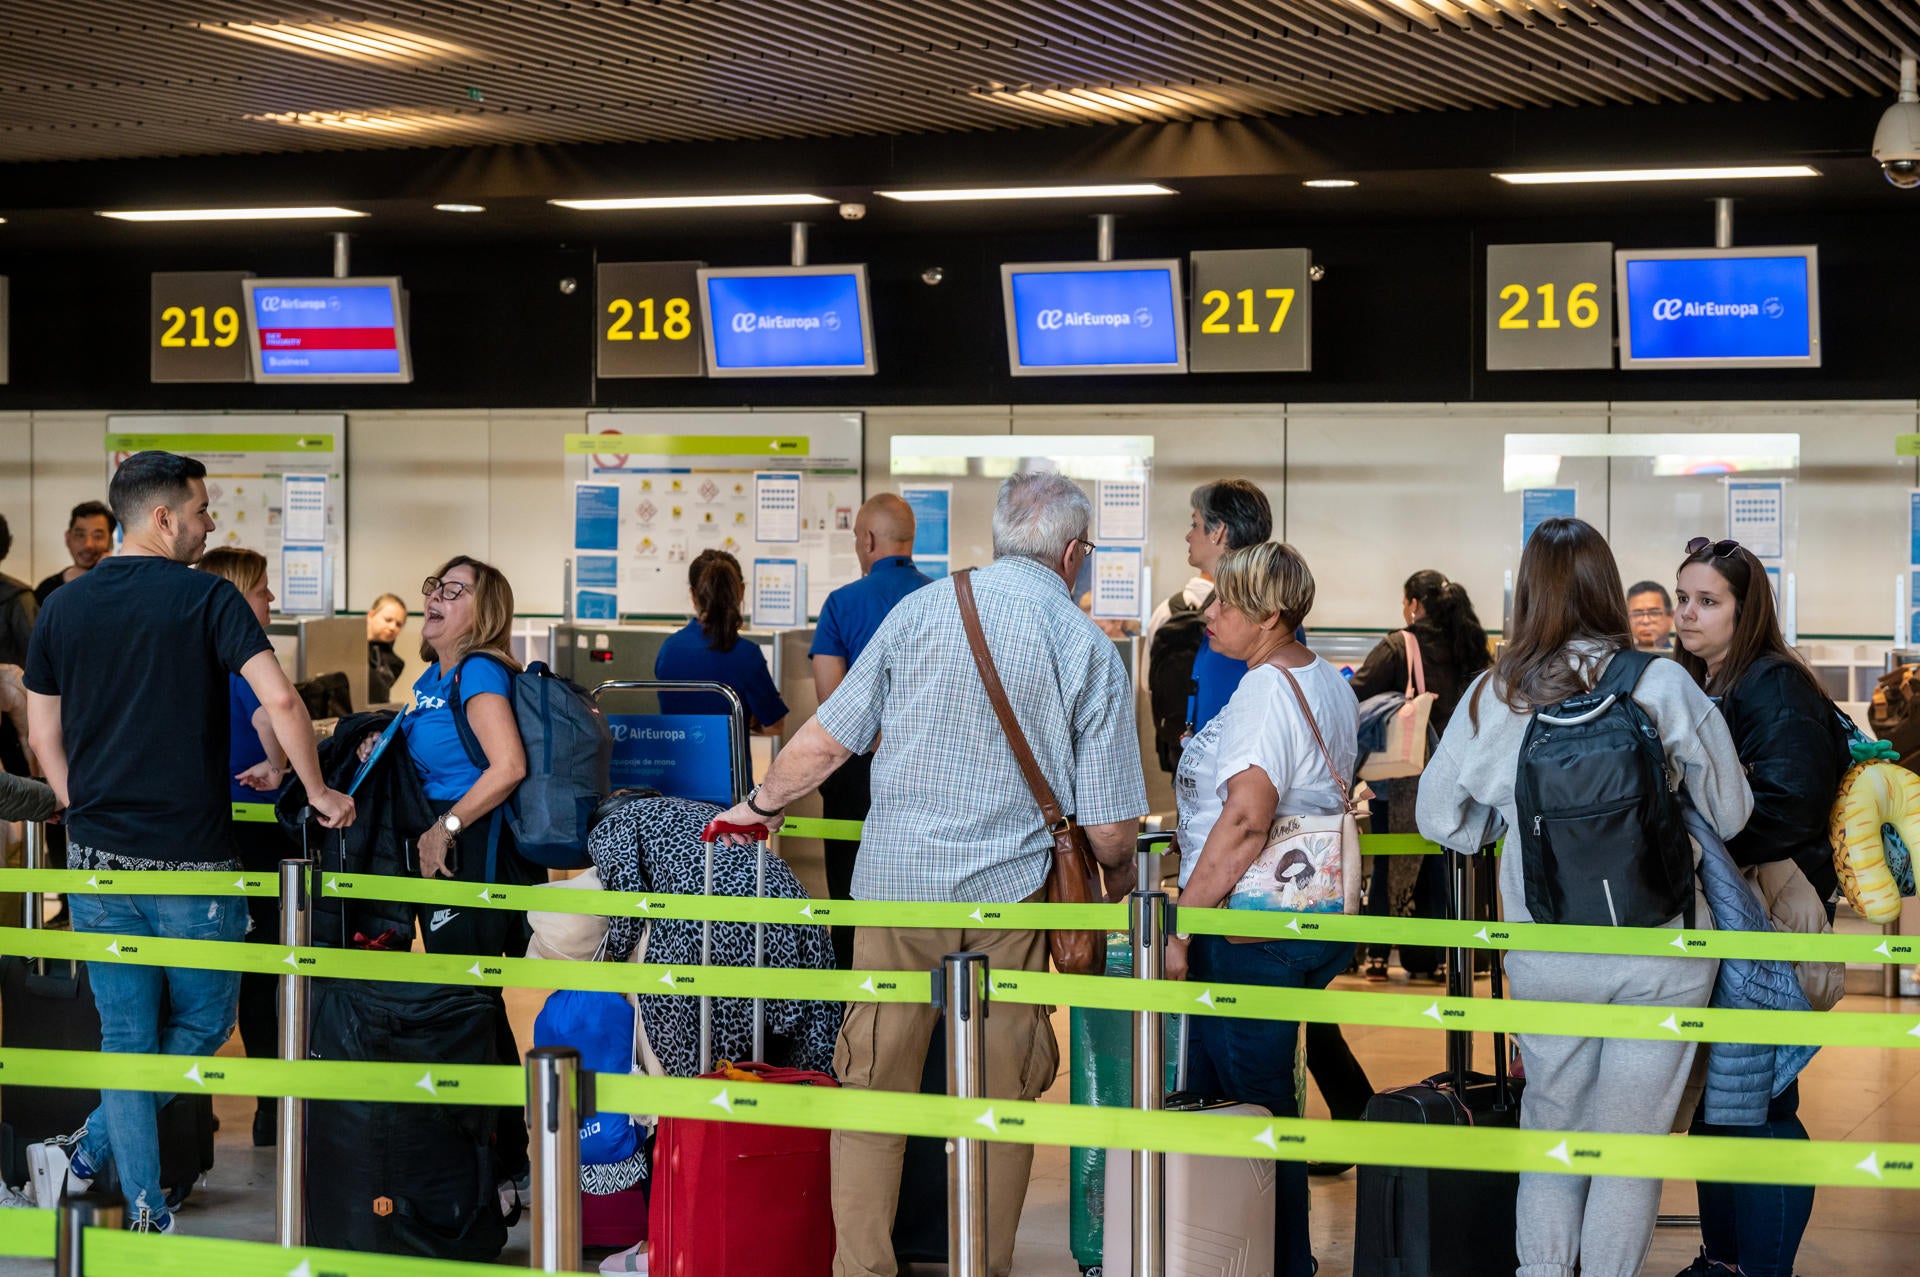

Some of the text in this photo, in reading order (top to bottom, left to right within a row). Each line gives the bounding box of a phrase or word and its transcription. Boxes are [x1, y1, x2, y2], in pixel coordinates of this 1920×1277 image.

[1498, 282, 1599, 329] 216
[1201, 288, 1295, 334] 217
[1684, 302, 1758, 318] AirEuropa
[606, 298, 692, 341] 218
[757, 315, 820, 331] AirEuropa
[1064, 312, 1130, 327] AirEuropa
[161, 306, 239, 347] 219
[269, 356, 310, 367] Business
[629, 727, 686, 742] AirEuropa
[337, 881, 353, 889] aena
[120, 945, 138, 953] aena
[298, 957, 317, 965] aena
[483, 967, 502, 975] aena
[675, 976, 695, 984] aena
[1215, 996, 1237, 1004] aena
[1443, 1009, 1465, 1017] aena
[436, 1079, 460, 1088] aena
[733, 1098, 758, 1106] aena
[1000, 1118, 1024, 1126] aena
[1279, 1135, 1305, 1143] aena
[1574, 1150, 1601, 1158] aena
[1884, 1162, 1913, 1170] aena
